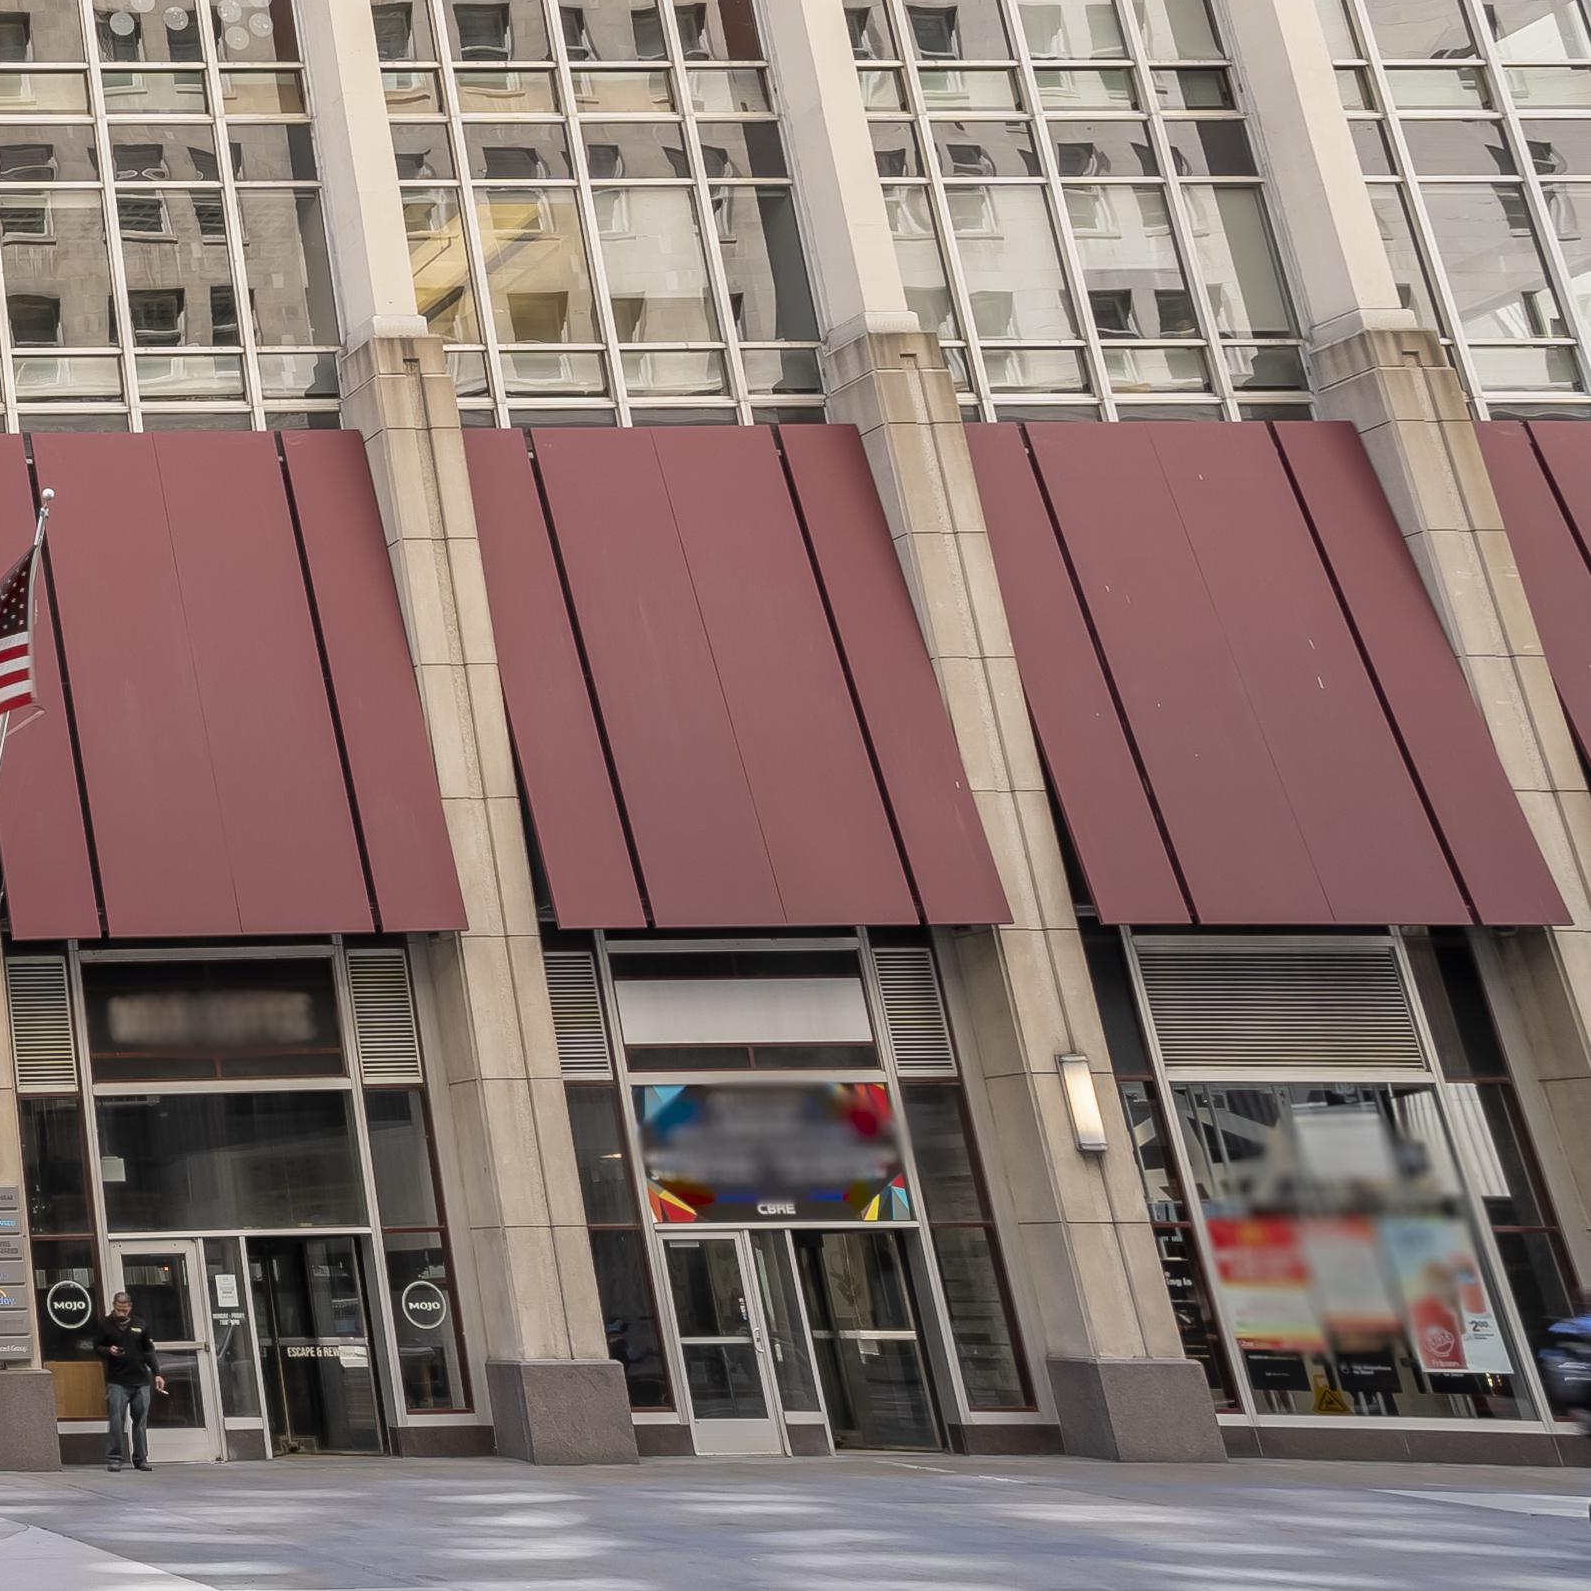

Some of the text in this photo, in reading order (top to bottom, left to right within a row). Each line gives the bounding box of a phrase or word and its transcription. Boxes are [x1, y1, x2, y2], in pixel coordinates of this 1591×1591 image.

[757, 1203, 797, 1215] CBRE
[53, 1301, 86, 1311] MOJO
[407, 1301, 441, 1311] MOJO
[286, 1346, 316, 1358] ESCAPE
[316, 1347, 323, 1358] &
